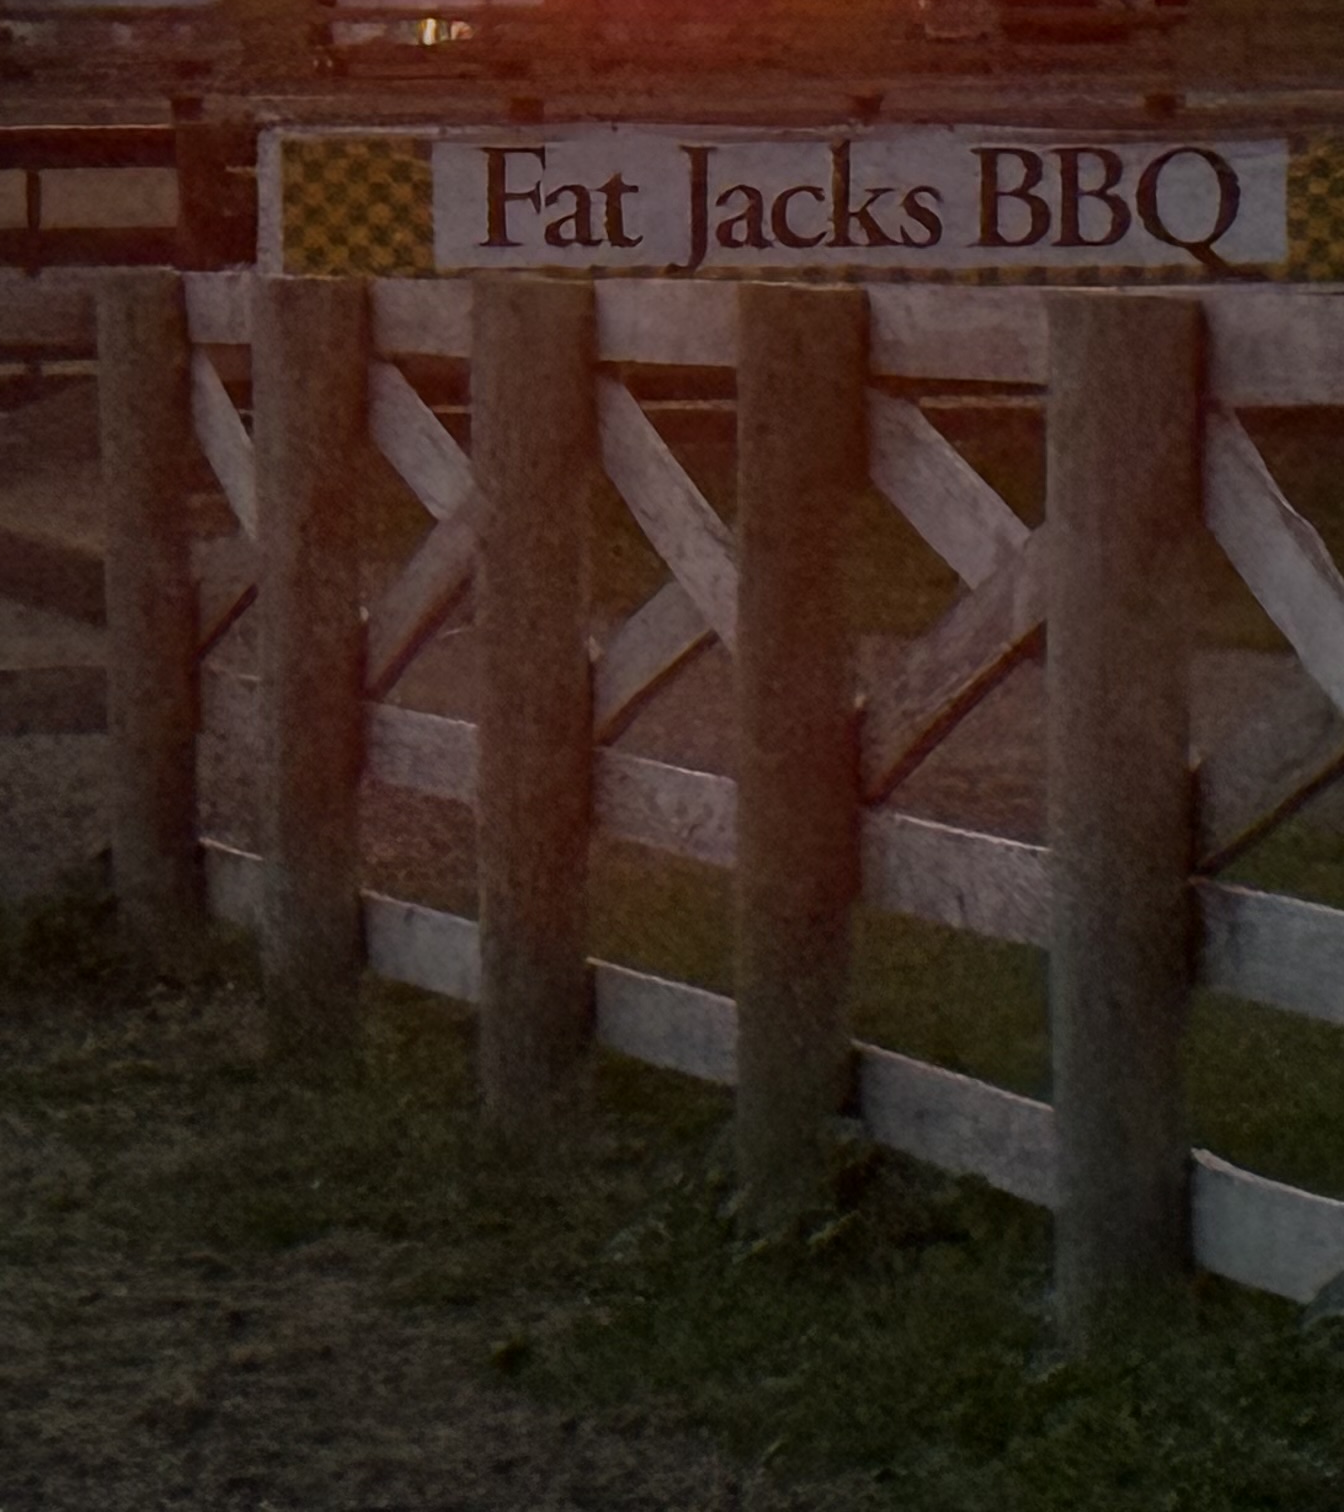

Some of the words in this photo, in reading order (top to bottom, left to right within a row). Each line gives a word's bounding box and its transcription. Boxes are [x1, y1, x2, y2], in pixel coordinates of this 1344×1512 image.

[479, 146, 644, 248] Fat
[663, 139, 943, 274] Jacks
[967, 146, 1268, 281] BBQ
